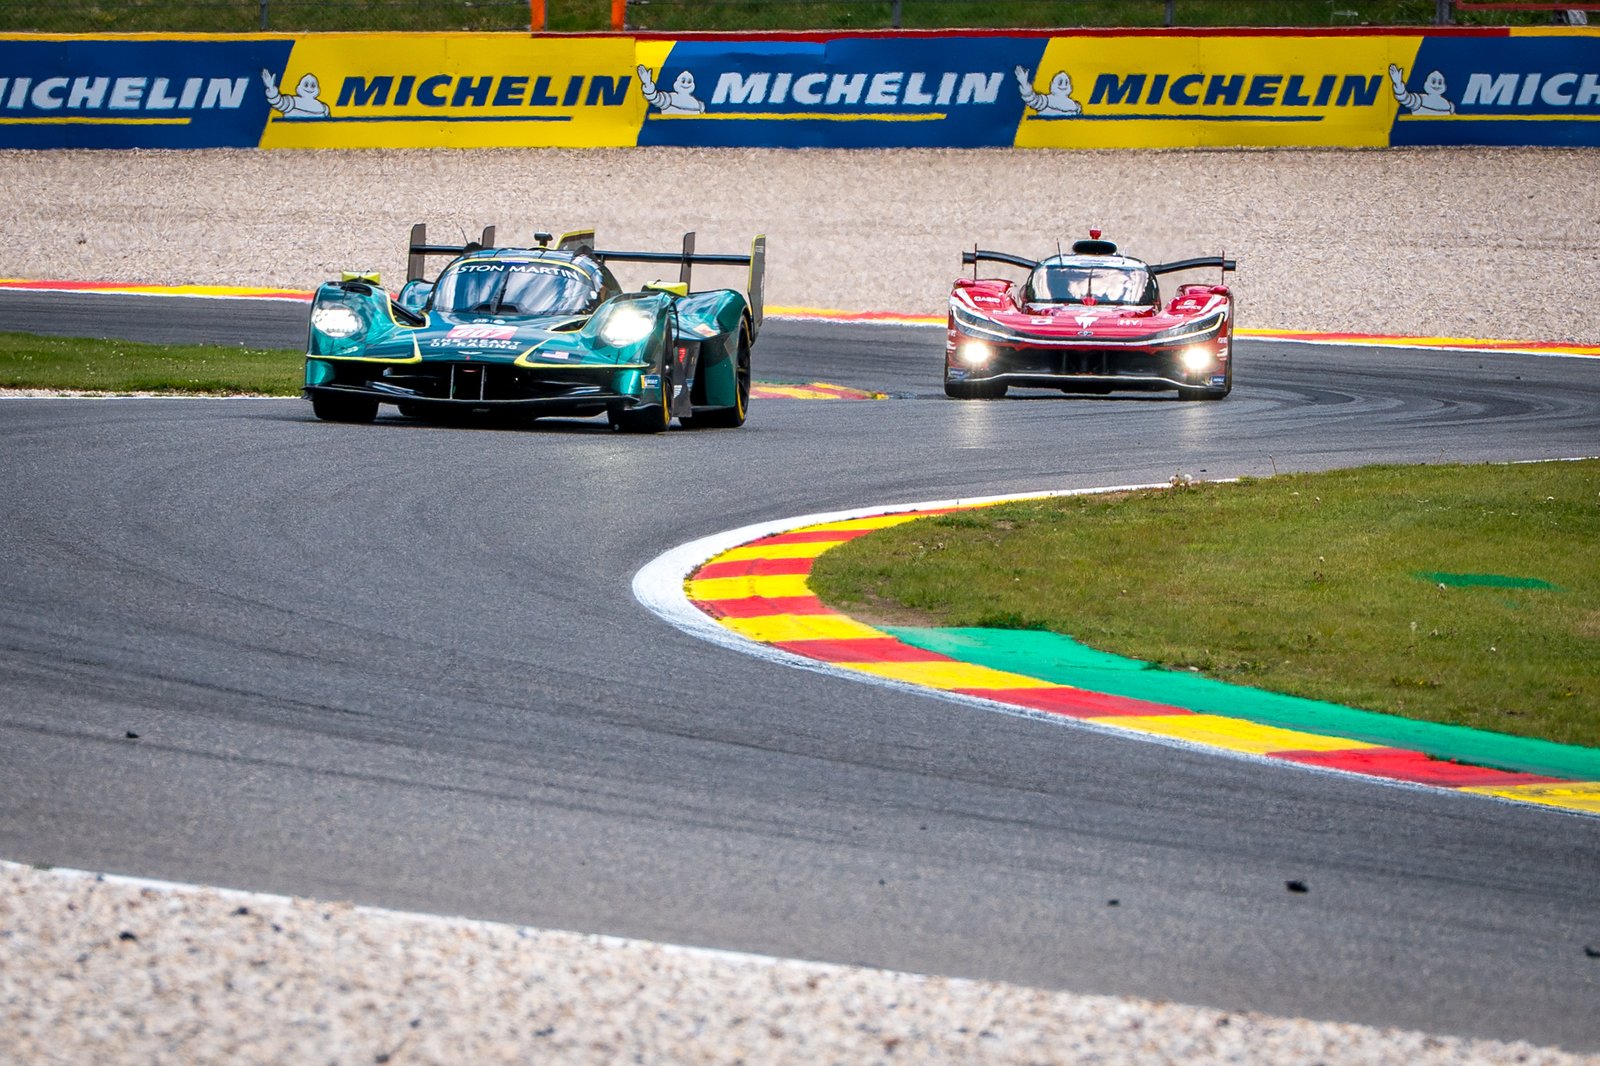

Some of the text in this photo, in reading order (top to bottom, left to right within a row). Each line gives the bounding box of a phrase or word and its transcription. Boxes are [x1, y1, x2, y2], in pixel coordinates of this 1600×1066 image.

[0, 76, 250, 110] ICHELIN
[335, 74, 632, 107] MICHELIN
[711, 72, 1004, 105] MICHELIN
[1088, 73, 1383, 107] MICHELIN
[509, 265, 580, 281] MARTIN
[973, 295, 1001, 304] CASIO
[456, 342, 518, 350] RACING
[468, 338, 523, 346] HEART
